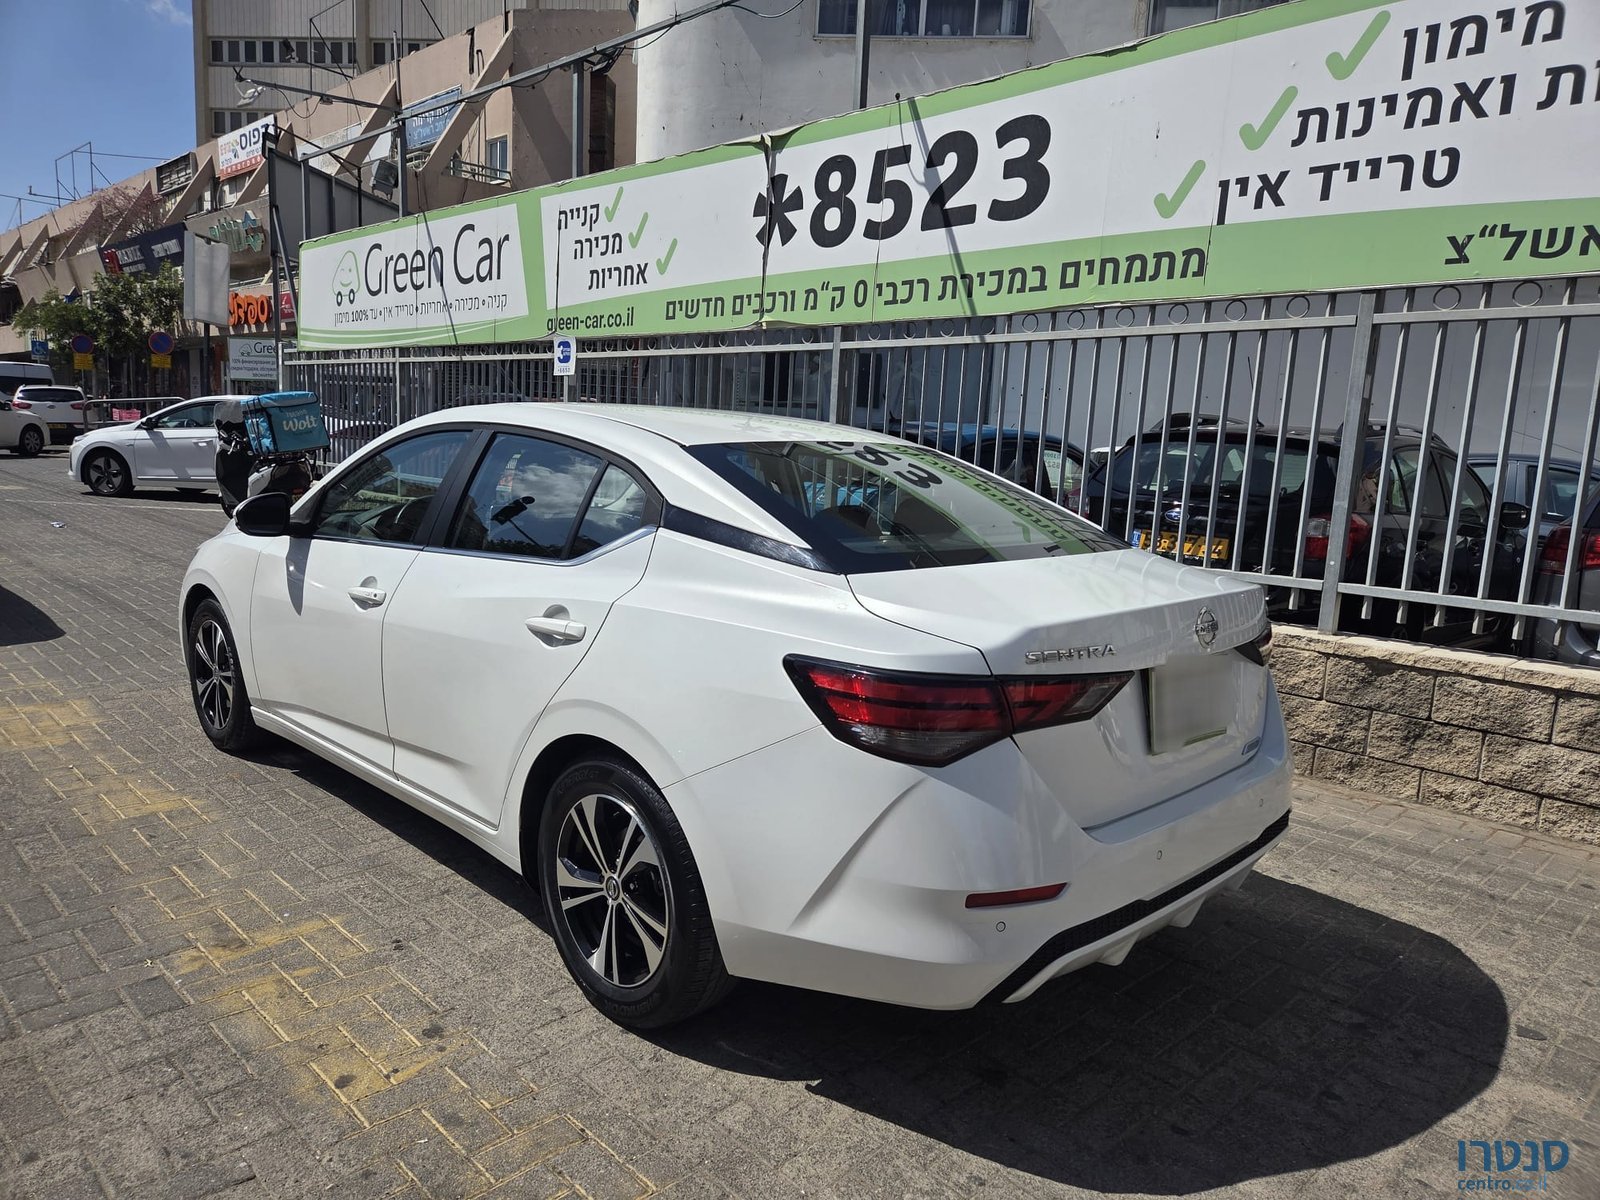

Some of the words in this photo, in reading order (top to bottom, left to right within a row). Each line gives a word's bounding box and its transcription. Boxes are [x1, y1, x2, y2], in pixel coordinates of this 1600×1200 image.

[1401, 0, 1566, 81] מימון
[1290, 73, 1517, 148] ואמינות
[1307, 146, 1461, 202] טרייד
[1216, 169, 1291, 226] אין
[558, 203, 600, 232] קנייה
[364, 242, 444, 297] Green
[453, 223, 510, 285] Car
[573, 232, 623, 260] מכירה
[588, 262, 649, 291] אחריות
[1059, 247, 1206, 289] מתמחים
[853, 279, 868, 308] 0
[876, 279, 928, 306] רכבי
[938, 265, 1047, 301] במכירת
[351, 310, 369, 322] 100%
[420, 299, 448, 315] אחריות
[454, 297, 480, 312] מכירה
[487, 294, 508, 312] קניה
[665, 296, 725, 321] חדשים
[732, 289, 796, 316] ורכבים
[253, 341, 278, 354] Gree
[282, 415, 318, 432] Wolt
[1024, 643, 1117, 665] SENTRA
